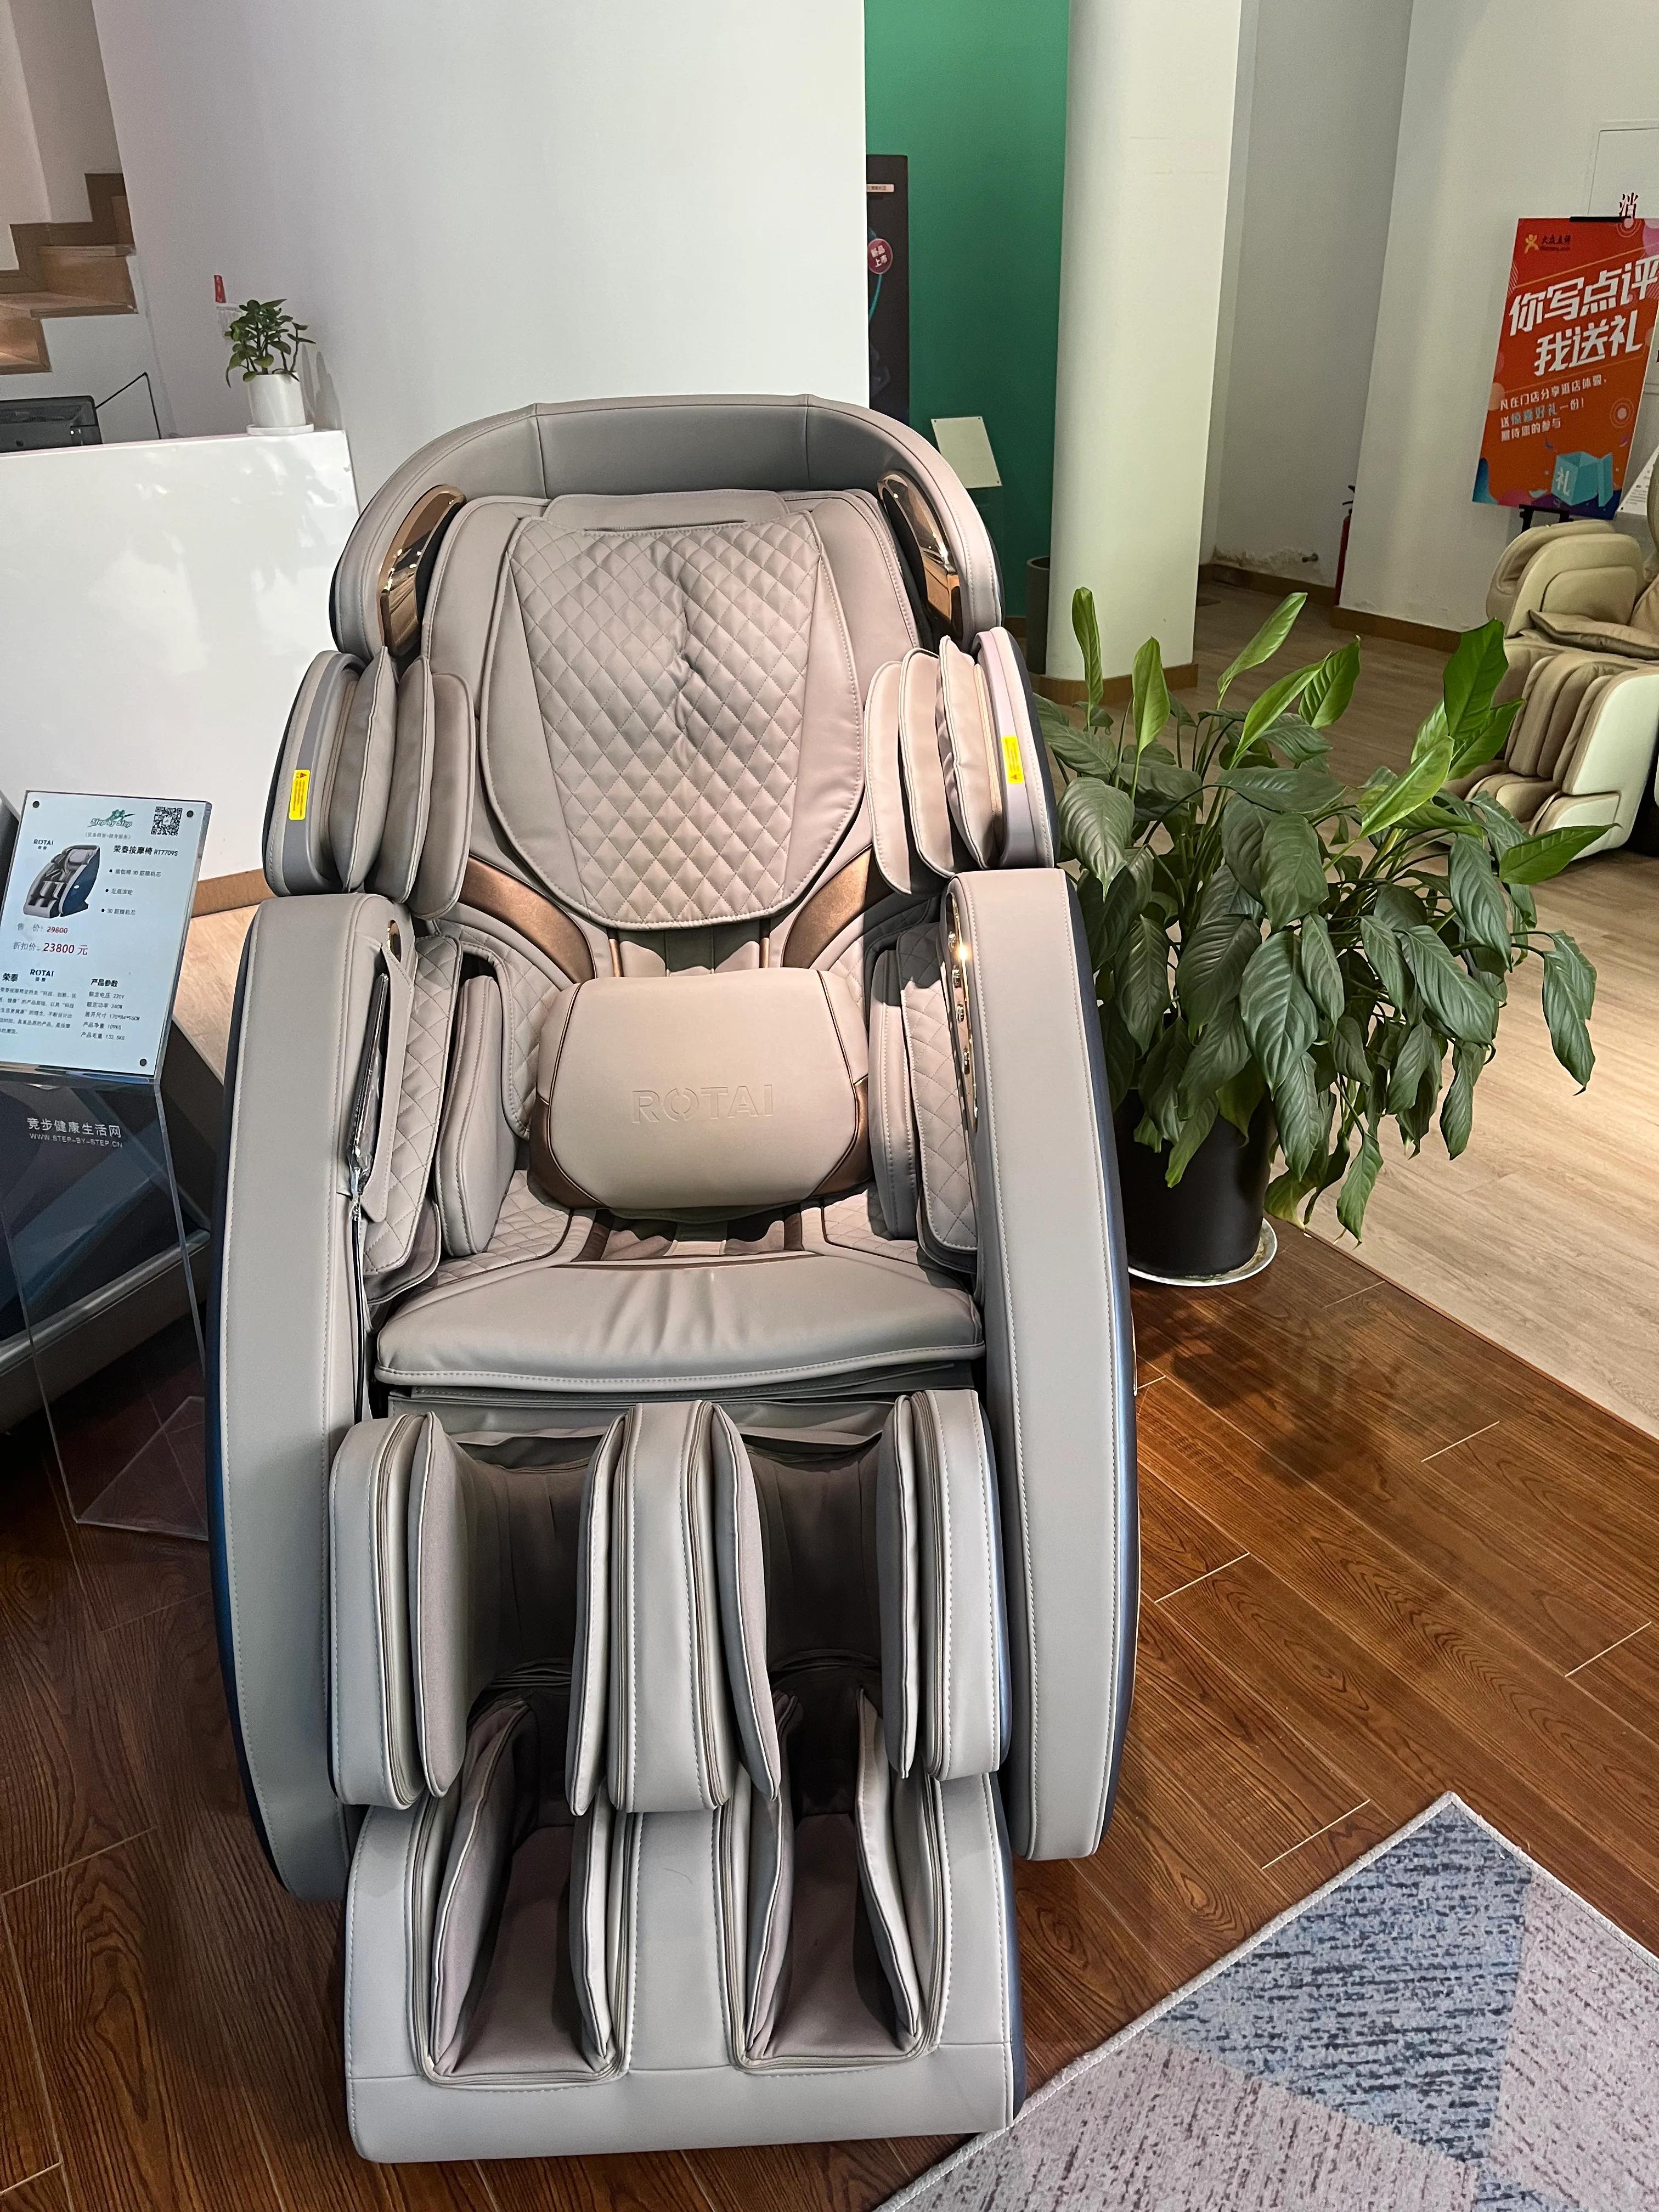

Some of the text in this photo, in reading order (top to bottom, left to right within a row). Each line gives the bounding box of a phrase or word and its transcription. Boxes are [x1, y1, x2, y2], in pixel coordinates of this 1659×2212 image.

[1509, 255, 1659, 336] 你写点评
[1534, 309, 1643, 376] 我送礼
[1555, 468, 1571, 497] 礼
[113, 845, 153, 855] 荣泰按摩椅
[43, 943, 75, 953] 23800
[76, 945, 88, 956] 元
[2, 969, 54, 982] 荣泰 ROTAI
[91, 978, 118, 987] 产品参数
[632, 1084, 773, 1124] ROTAI
[29, 1133, 123, 1148] WWW.STEP-BY-STEP.CN
